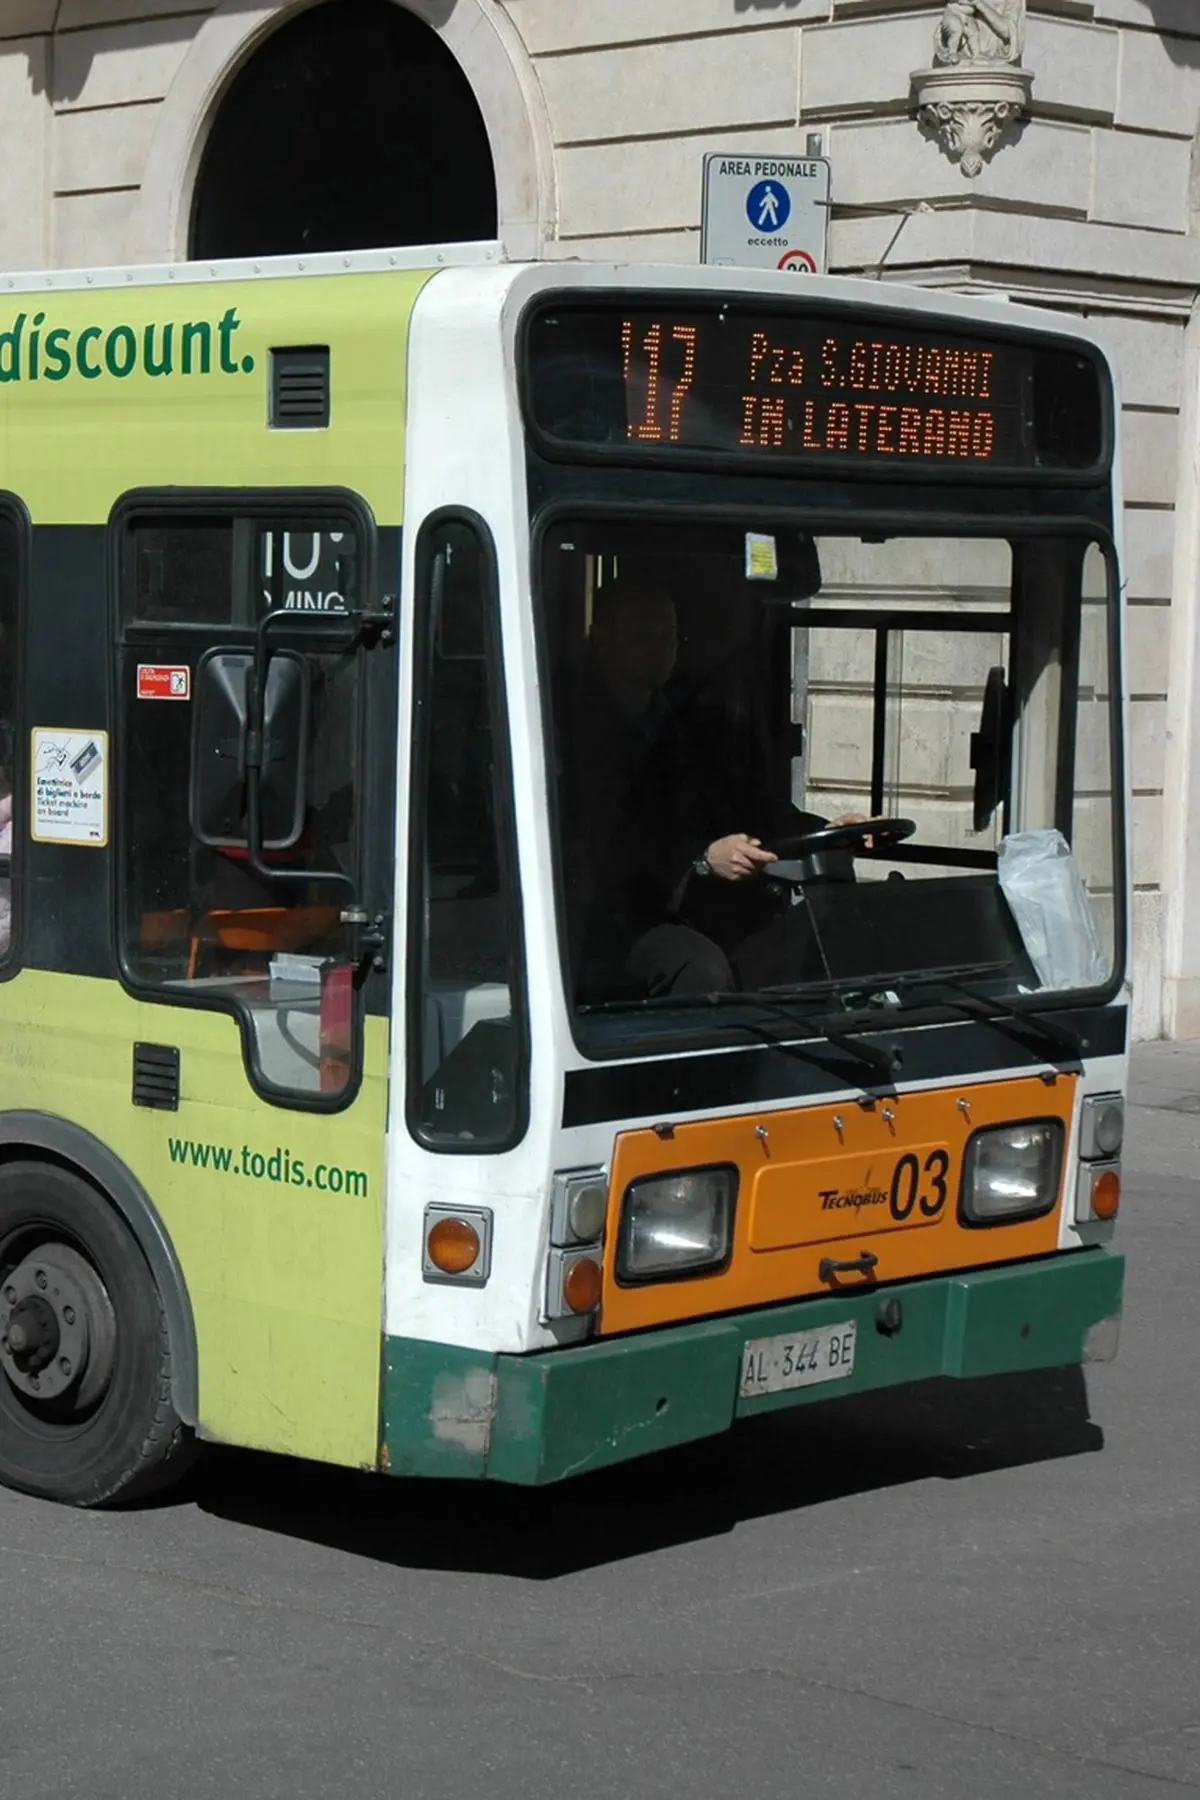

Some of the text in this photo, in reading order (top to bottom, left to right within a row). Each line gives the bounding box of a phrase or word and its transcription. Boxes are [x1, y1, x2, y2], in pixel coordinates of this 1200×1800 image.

[719, 161, 817, 177] AREA PEDONALE
[747, 237, 789, 247] eccetto
[0, 307, 255, 382] discount.
[750, 332, 804, 384] Pza
[168, 1137, 368, 1198] www.todis.com
[888, 1148, 949, 1221] 03
[744, 1333, 852, 1386] AL 344 BE
